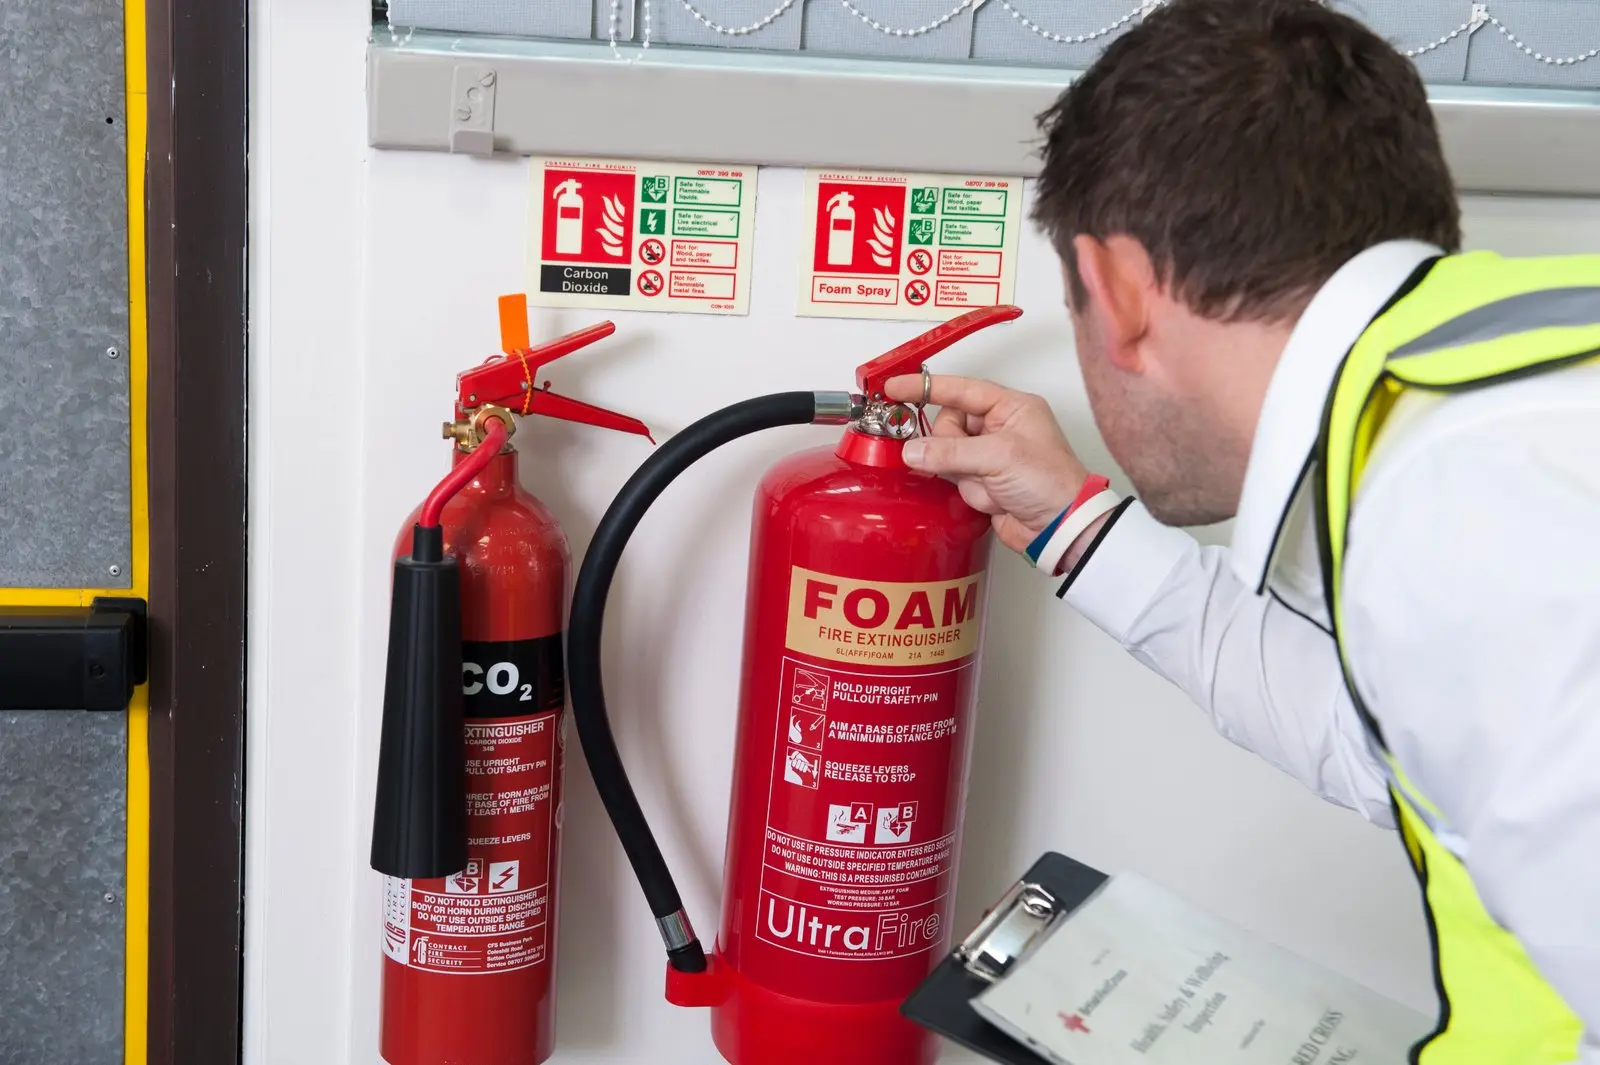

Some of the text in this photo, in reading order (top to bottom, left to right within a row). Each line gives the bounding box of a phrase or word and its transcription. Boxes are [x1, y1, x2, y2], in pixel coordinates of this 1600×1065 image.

[658, 178, 667, 189] B
[680, 187, 710, 195] Flammable
[926, 189, 935, 200] A
[924, 220, 933, 231] B
[676, 250, 694, 258] Wood,
[563, 267, 609, 279] Carbon
[562, 281, 608, 293] Dioxide
[819, 284, 891, 297] Foam Spray
[804, 579, 978, 630] FOAM
[819, 626, 960, 647] FIRE EXTINGUISHER
[908, 652, 922, 660] 21A
[833, 681, 911, 695] HOLD UPRIGHT
[832, 691, 938, 705] PULLOUT SAFETY PIN
[829, 717, 955, 734] AIM AT BASE OF FIRE FROM
[469, 738, 497, 746] CARBON
[498, 736, 523, 745] DIOXIDE
[828, 729, 836, 739] A
[837, 731, 884, 743] MINIMUM
[886, 731, 933, 743] DISTANCE
[934, 729, 945, 739] OF
[483, 757, 521, 767] UPRIGHT
[486, 759, 547, 775] OUT SAFETY PIN
[824, 760, 909, 774] SQUEEZE LEVERS
[824, 770, 916, 783] RELEASE TO STOP
[475, 791, 549, 808] BASE OF FIRE FROM
[498, 790, 521, 800] HORN
[522, 787, 538, 797] AND
[474, 807, 501, 816] LEAST
[509, 803, 535, 814] METRE
[854, 807, 867, 820] A
[902, 806, 913, 819] B
[502, 832, 531, 844] LEVERS
[767, 830, 935, 860] DO NOT USE IF PRESSURE INDICATOR ENTERS RED
[771, 844, 781, 855] DO
[781, 848, 796, 860] NOT
[796, 854, 811, 865] USE
[812, 857, 845, 870] OUTSIDE
[846, 861, 886, 872] SPECIFIED
[887, 854, 933, 870] TEMPERATURE
[467, 862, 478, 875] B
[839, 873, 847, 882] IS
[848, 874, 854, 883] A
[854, 873, 906, 884] PRESSURISED
[906, 865, 939, 881] CONTAINER
[424, 890, 537, 907] DO NOT HOLD EXTINGUISHER
[412, 895, 547, 916] BODY OR HORN DURING DISCHARGE
[417, 906, 541, 925] DO NOT USE OUTSIDE SPECIFIED
[436, 919, 525, 933] TEMPERATURE RANGE
[428, 942, 468, 951] CONTRACT
[428, 958, 463, 966] SECURITY
[1309, 1009, 1344, 1046] CROSS
